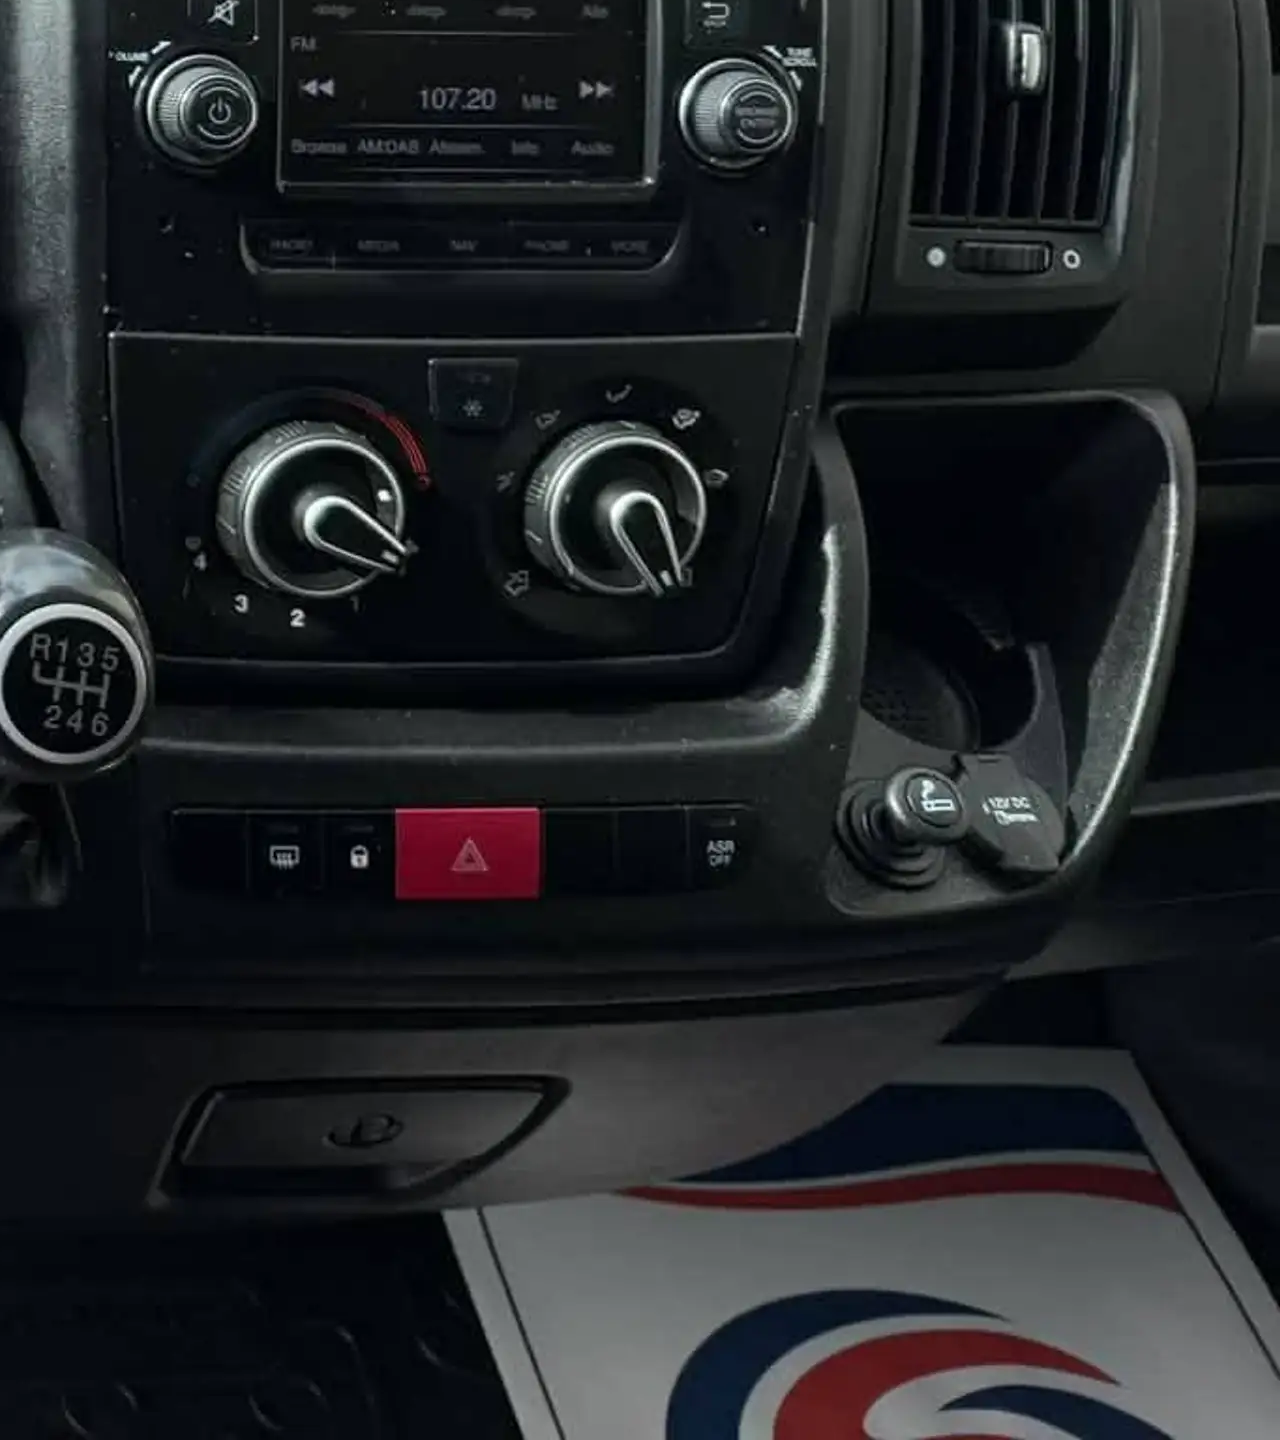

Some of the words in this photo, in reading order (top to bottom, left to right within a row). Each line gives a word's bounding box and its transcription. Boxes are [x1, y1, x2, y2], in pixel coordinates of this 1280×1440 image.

[291, 38, 317, 52] FM
[419, 87, 497, 111] 107.20
[193, 552, 208, 571] 4
[234, 594, 250, 613] 3
[289, 609, 306, 627] 2
[30, 633, 52, 661] R
[55, 637, 69, 664] 1
[77, 642, 95, 668] 3
[100, 647, 121, 672] 5
[42, 705, 61, 730] 2
[66, 708, 84, 734] 4
[91, 712, 110, 737] 6
[707, 840, 735, 854] ASR
